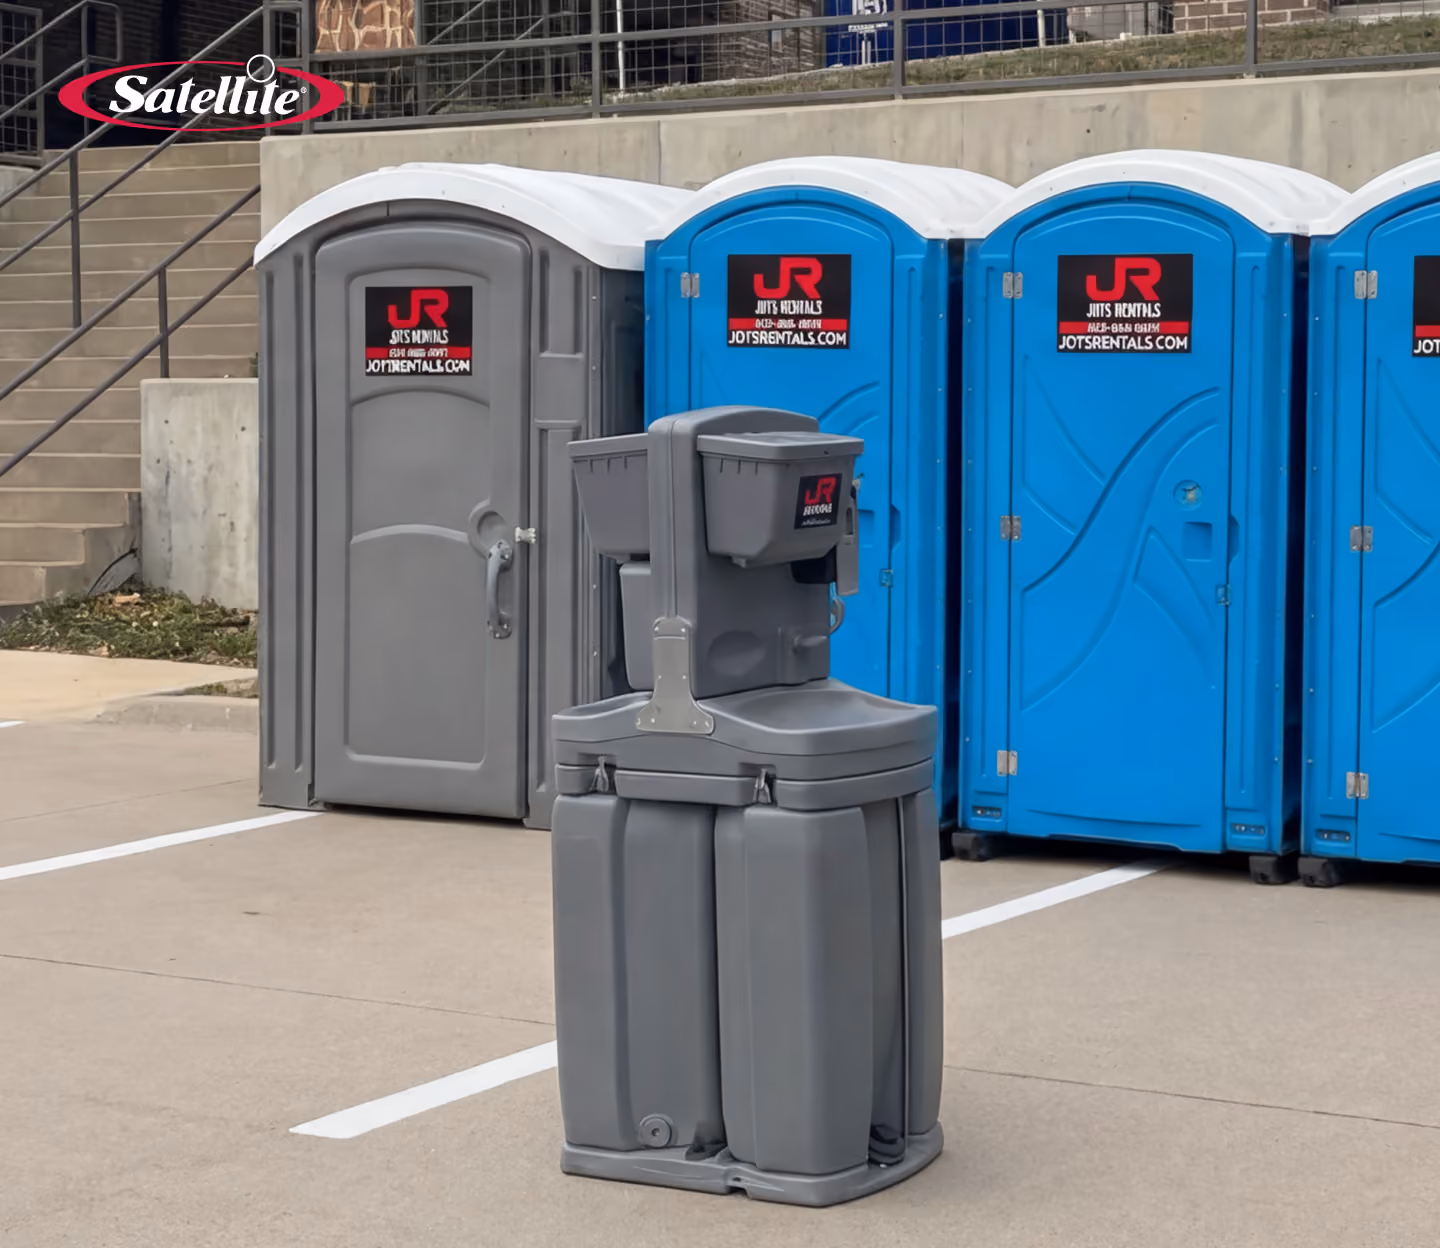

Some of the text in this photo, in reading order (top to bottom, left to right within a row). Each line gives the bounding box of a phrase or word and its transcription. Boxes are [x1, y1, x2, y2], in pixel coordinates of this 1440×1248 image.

[753, 257, 823, 299] JR
[1086, 257, 1162, 301] JR
[388, 289, 449, 328] JR
[805, 477, 837, 505] JR
